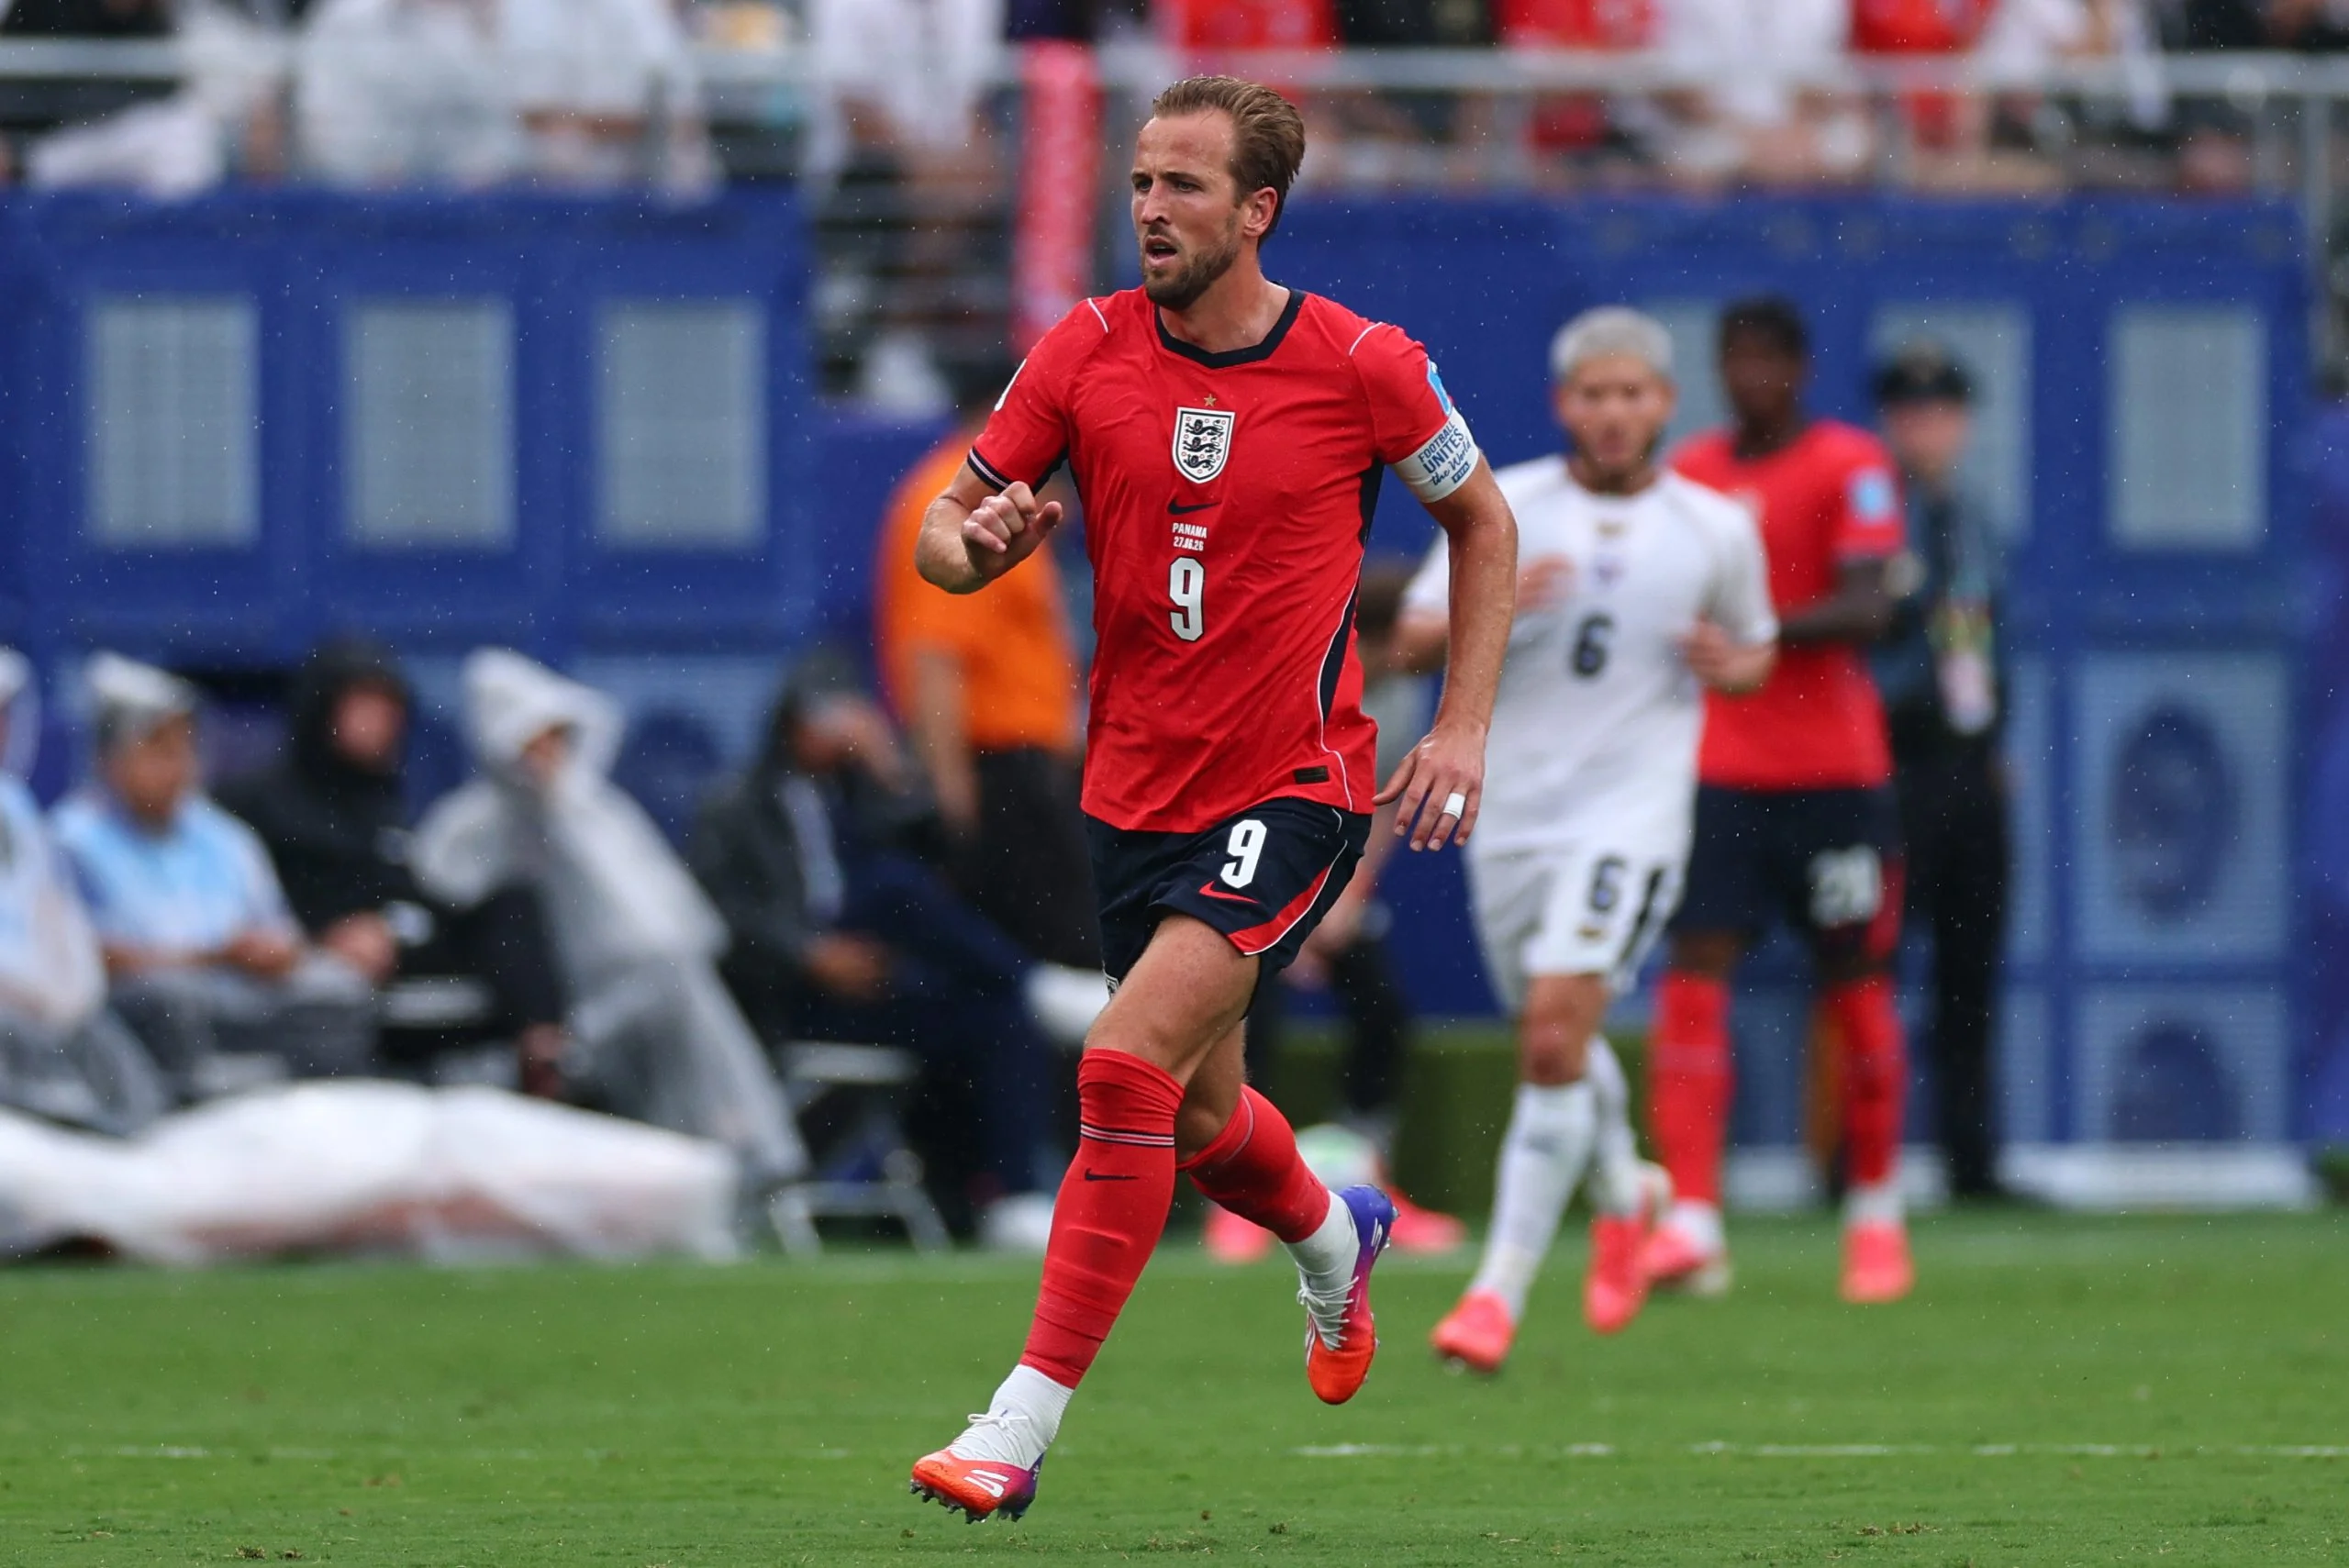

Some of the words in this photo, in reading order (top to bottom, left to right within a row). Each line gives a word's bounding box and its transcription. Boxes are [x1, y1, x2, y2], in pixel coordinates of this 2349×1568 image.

[1418, 421, 1456, 463] FOOTBALL
[1423, 428, 1464, 473] UNITES
[1430, 469, 1451, 486] the
[1447, 437, 1472, 472] World
[1172, 522, 1208, 539] PANAMA
[1169, 556, 1205, 642] 9
[1570, 614, 1614, 677] 6
[1220, 819, 1267, 889] 9
[1588, 858, 1627, 912] 6
